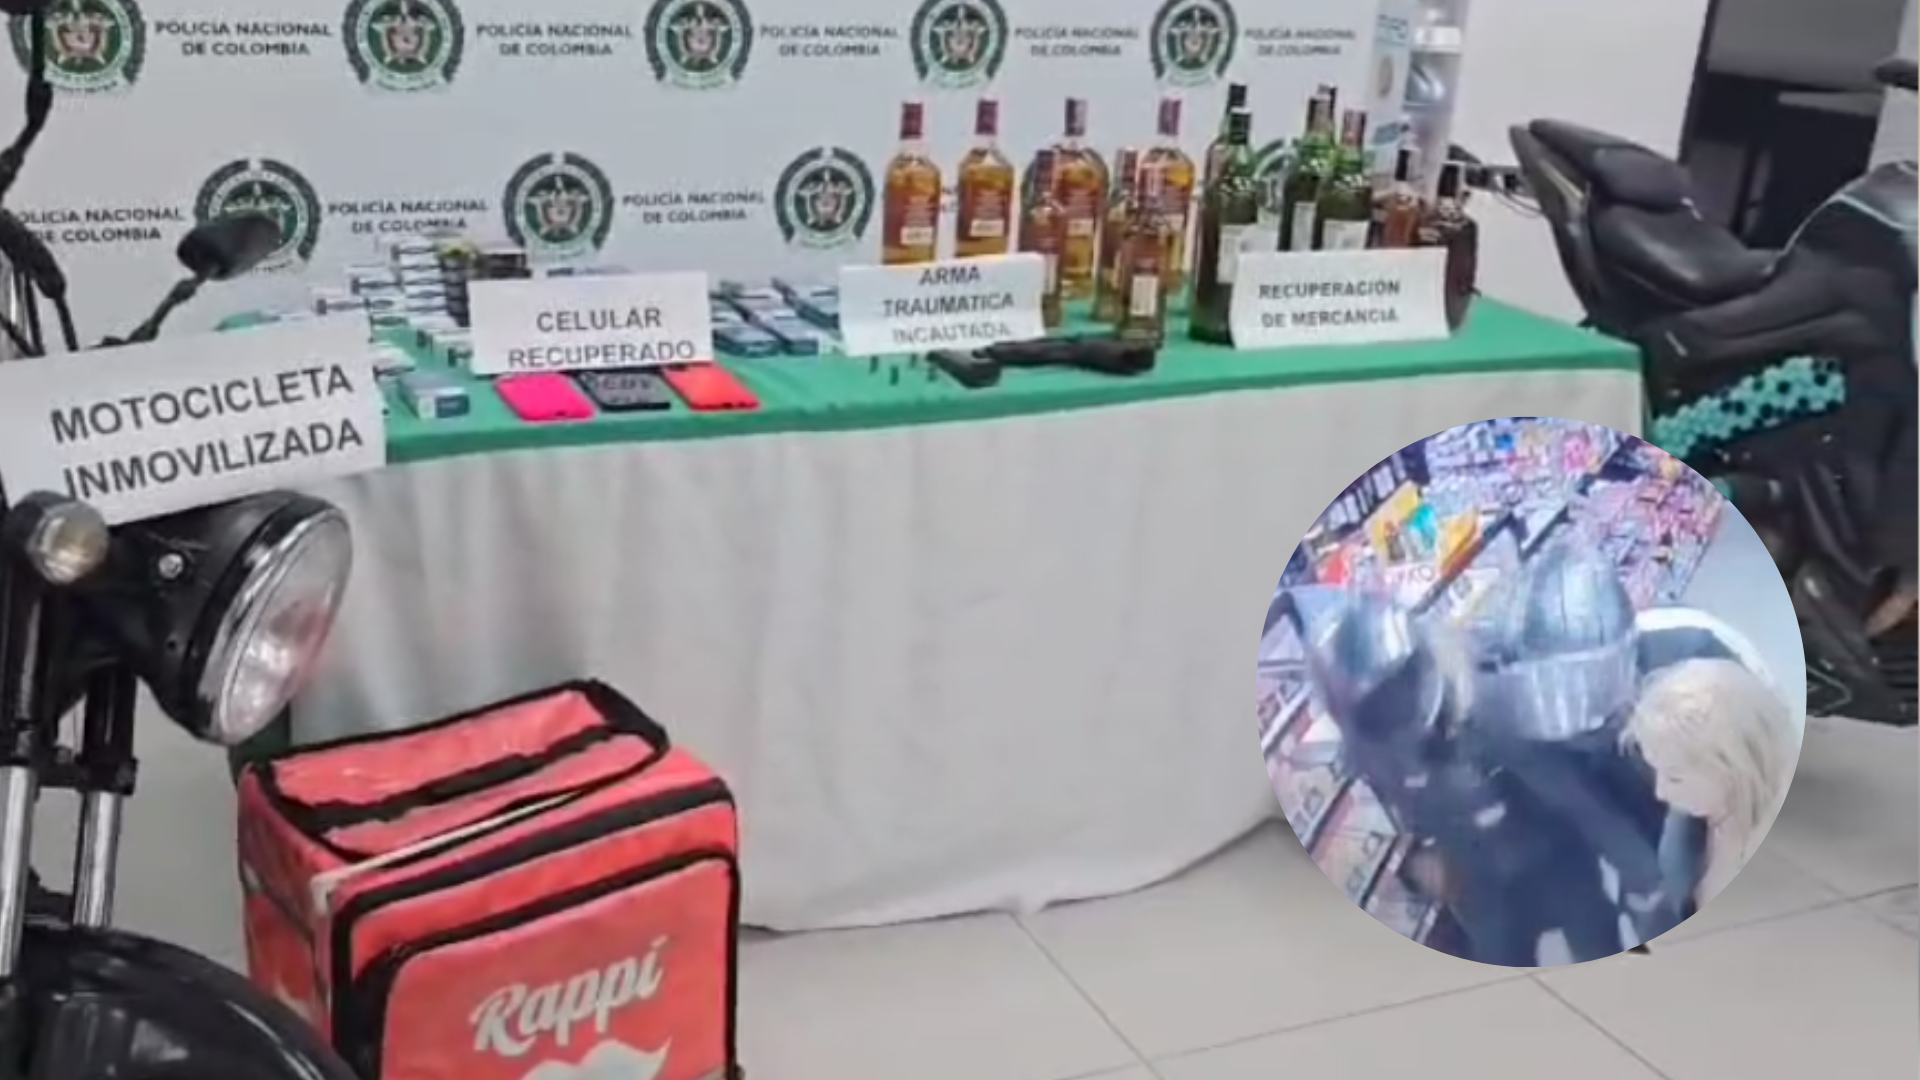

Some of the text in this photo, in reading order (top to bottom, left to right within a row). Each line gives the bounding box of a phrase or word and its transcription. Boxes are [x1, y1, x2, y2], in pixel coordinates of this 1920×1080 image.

[236, 22, 333, 37] NACIONAL
[548, 24, 634, 39] NACIONAL
[824, 25, 899, 39] NACIONAL
[182, 42, 311, 56] DE COLOMBIA
[500, 43, 613, 57] DE COLOMBIA
[779, 44, 881, 57] DE COLOMBIA
[1031, 45, 1121, 57] DE COLOMBIA
[687, 190, 765, 204] NACIONAL
[401, 200, 488, 213] NACIONAL
[16, 207, 186, 224] OLICIA NACIONAL
[643, 209, 747, 224] DE COLOMBIA
[352, 220, 373, 234] DE
[62, 227, 162, 243] COLOMBIA
[917, 266, 981, 286] ARMA
[883, 292, 1014, 317] TRAUMATICA
[536, 307, 662, 333] CELULAR
[1261, 308, 1398, 328] DE MERCANCIA
[893, 322, 1010, 345] INCAUTADA
[508, 340, 695, 369] RECUPERADO
[50, 364, 354, 443] MOTOCICLETA
[64, 418, 364, 500] INMOVILIZADA
[469, 935, 668, 1056] Rappi
